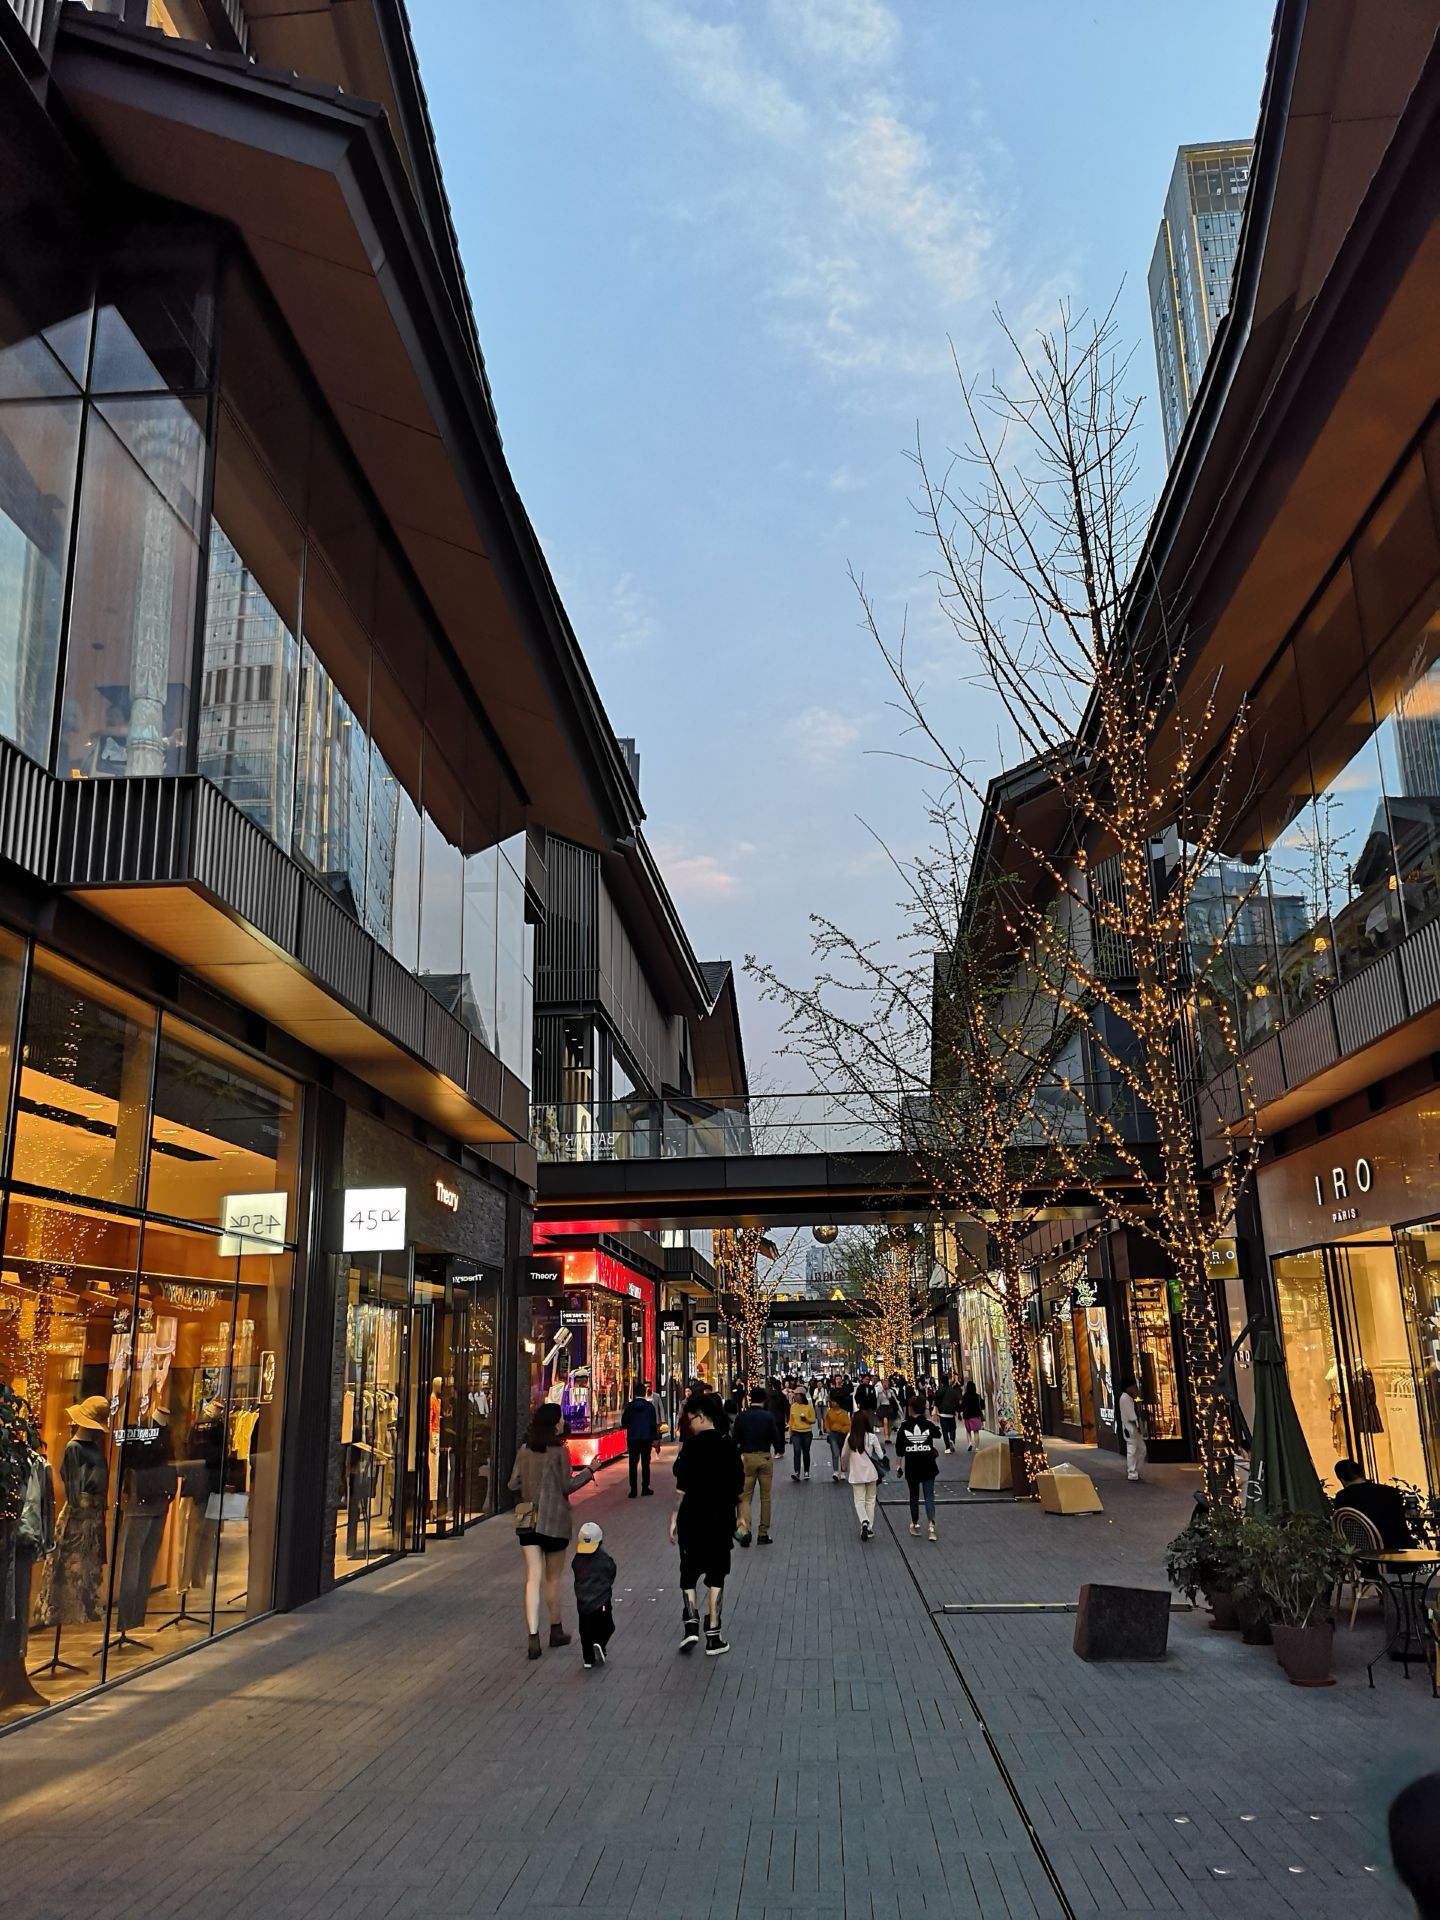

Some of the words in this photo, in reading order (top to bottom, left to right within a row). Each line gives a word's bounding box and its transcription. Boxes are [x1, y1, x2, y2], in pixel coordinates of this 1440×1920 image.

[1314, 1158, 1371, 1206] IRO
[435, 1181, 459, 1212] Theory
[1332, 1208, 1357, 1224] PARIS
[1211, 1250, 1235, 1260] RO
[530, 1272, 558, 1281] Theory
[696, 1322, 707, 1334] G
[1234, 1349, 1250, 1362] IRO
[905, 1444, 932, 1452] adidas
